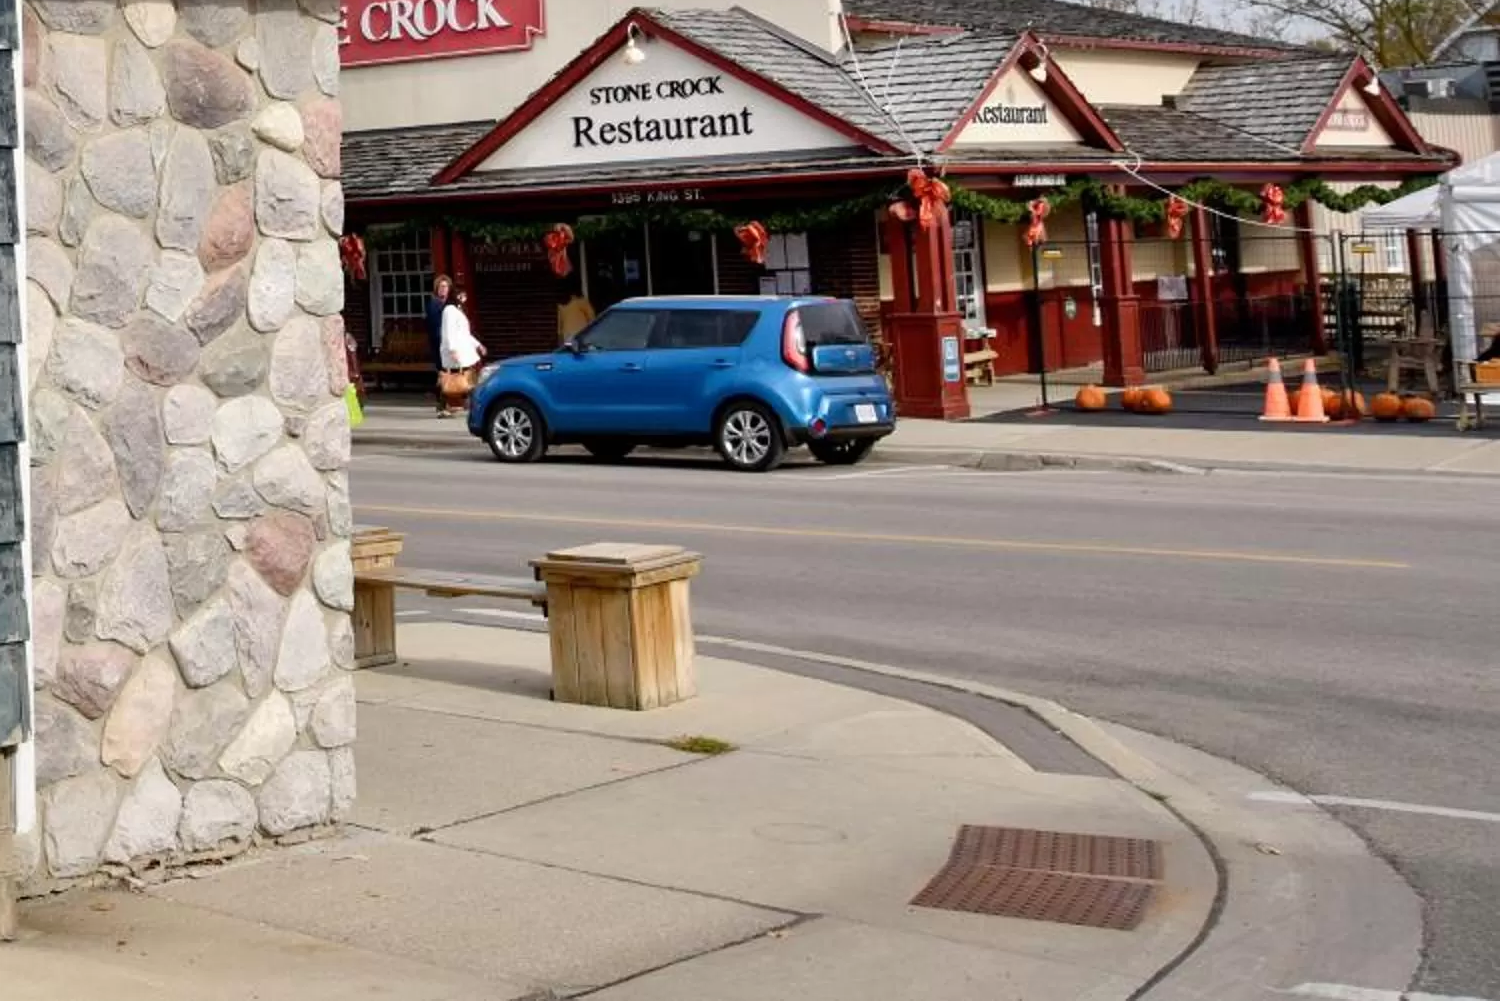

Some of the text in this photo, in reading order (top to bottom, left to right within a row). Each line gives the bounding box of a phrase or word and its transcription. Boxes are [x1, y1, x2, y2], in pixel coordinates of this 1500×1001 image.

[590, 75, 724, 105] STONE CROCK
[571, 106, 753, 148] Restaurant
[647, 190, 678, 202] KING
